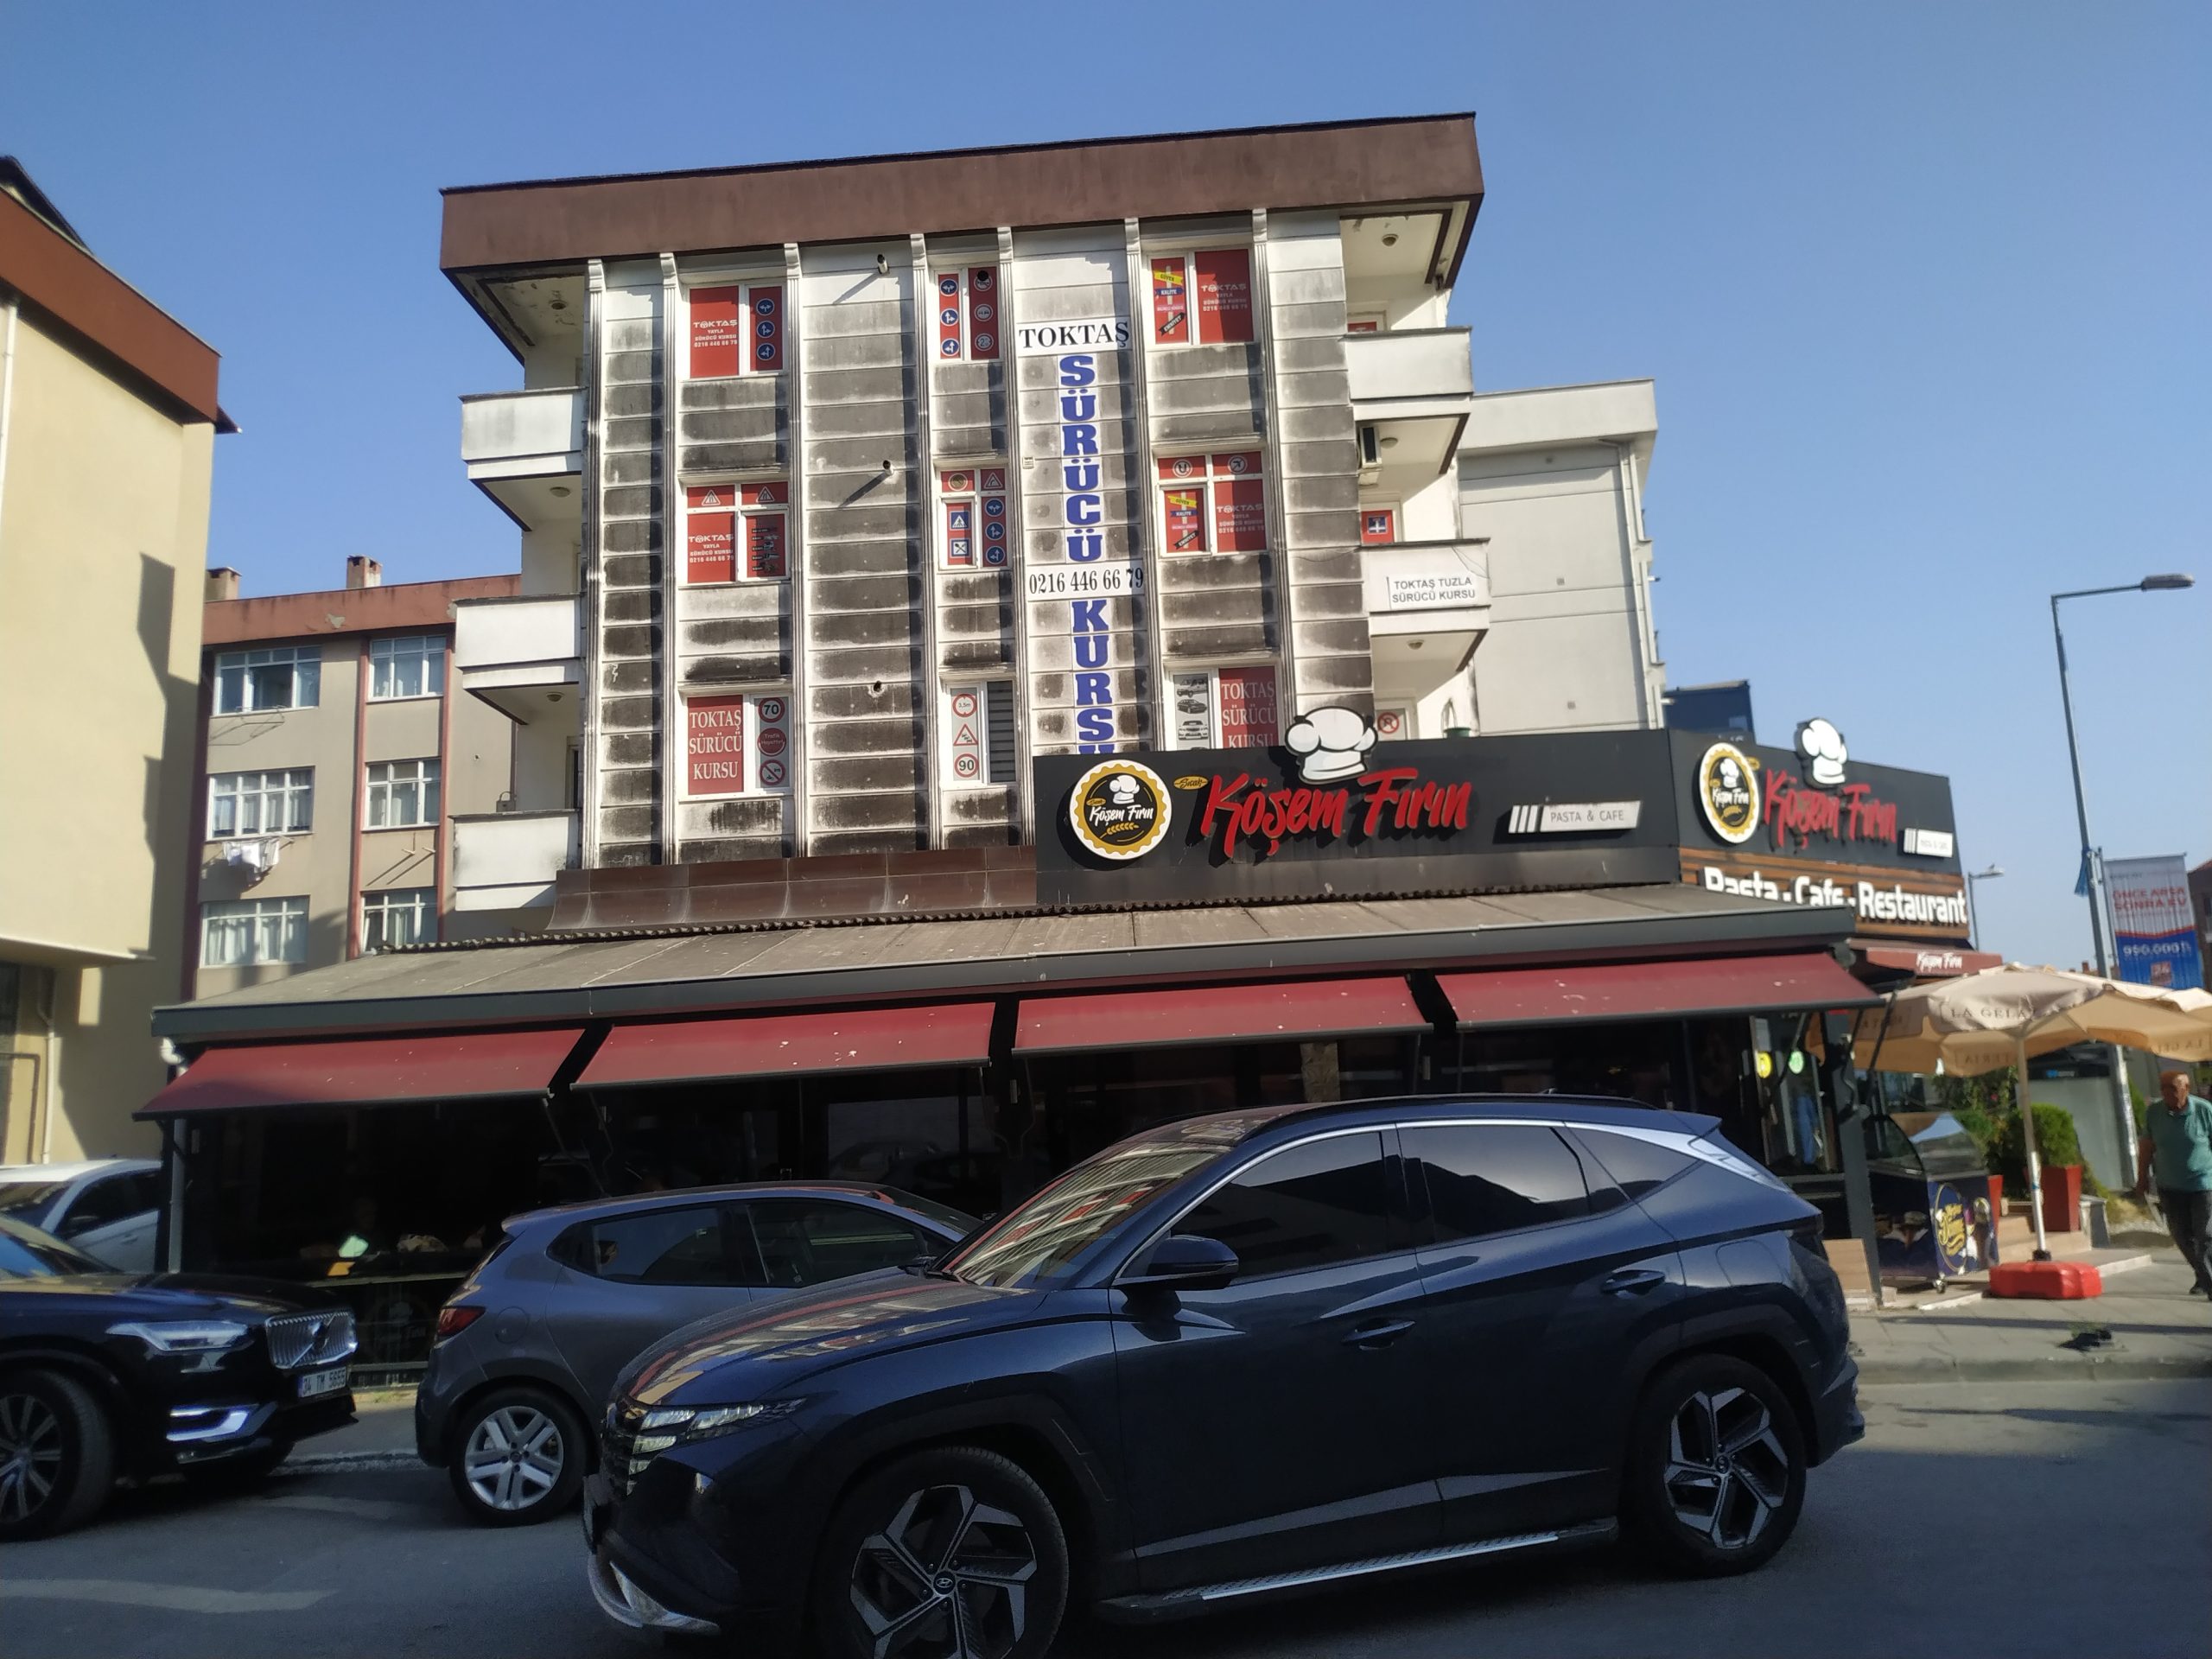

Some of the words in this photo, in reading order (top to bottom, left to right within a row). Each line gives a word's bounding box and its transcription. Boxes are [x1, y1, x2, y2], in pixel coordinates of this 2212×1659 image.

[693, 319, 738, 328] TOKTAŞ
[1019, 321, 1130, 348] TOKTAŞ
[1059, 355, 1103, 562] SÜRÜCÜ
[689, 534, 734, 543] TOKTAŞ
[1029, 573, 1065, 594] 0216
[1070, 571, 1097, 591] 446
[1103, 569, 1121, 589] 66
[1126, 568, 1144, 588] 79
[1394, 578, 1435, 590] TOKTAŞ
[1438, 576, 1472, 588] TUZLA
[1392, 590, 1436, 603] SÜRÜCÜ
[1439, 589, 1476, 601] KURSU
[1071, 599, 1116, 754] KURS
[1221, 681, 1274, 702] TOKTAŞ
[690, 709, 742, 730] TOKTAŞ
[764, 704, 779, 715] 70
[1222, 703, 1276, 726] SÜRÜCÜ
[689, 731, 742, 754] SÜRÜCÜ
[1228, 733, 1274, 748] KURSU
[694, 761, 739, 780] KURSU
[958, 760, 975, 771] 90
[1090, 805, 1125, 827] Köşem
[1127, 804, 1154, 821] Fırın
[1200, 773, 1349, 858] Köşem
[1357, 767, 1472, 836] Fırın
[1550, 811, 1581, 823] PASTA
[1586, 810, 1594, 822] &
[1599, 810, 1624, 821] CAFE
[1764, 768, 1840, 849] Köşem
[1857, 880, 1967, 925] Restaurant
[1952, 1007, 1973, 1018] LA
